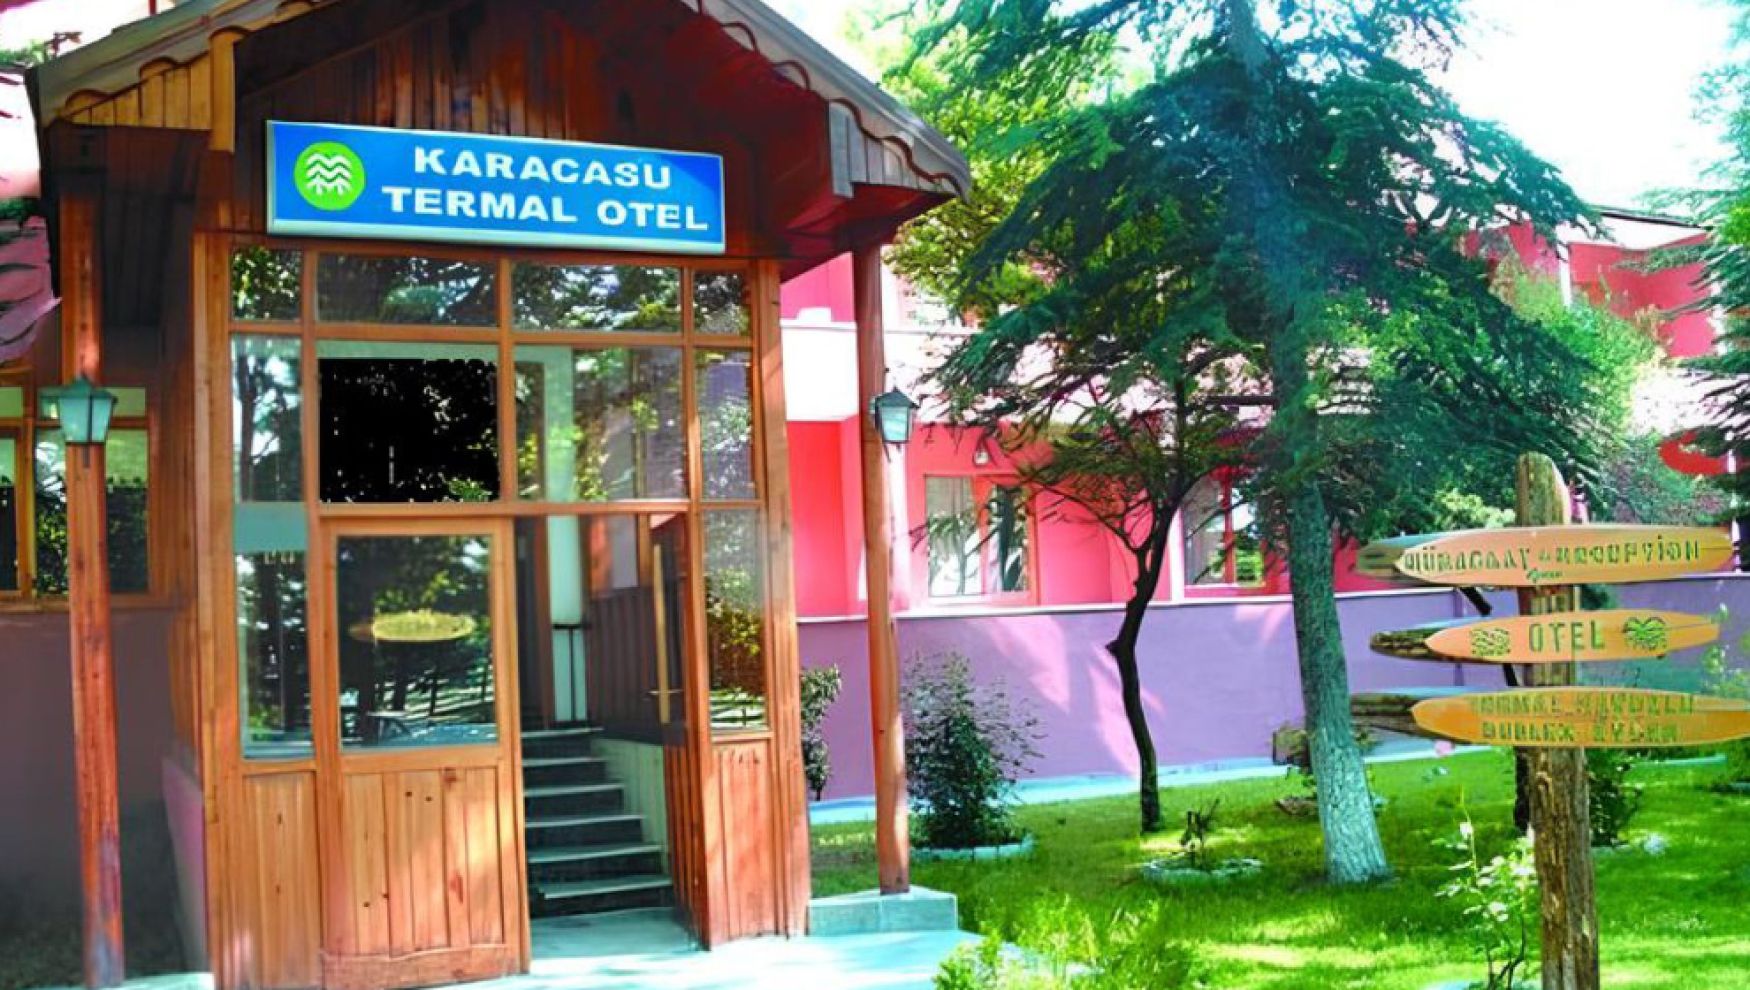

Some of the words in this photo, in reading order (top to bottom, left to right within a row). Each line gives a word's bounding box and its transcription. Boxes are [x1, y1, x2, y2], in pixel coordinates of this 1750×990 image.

[414, 146, 671, 190] KARACASU
[381, 185, 577, 223] TERMAL
[597, 200, 709, 231] OTEL
[1529, 620, 1605, 653] OTEL
